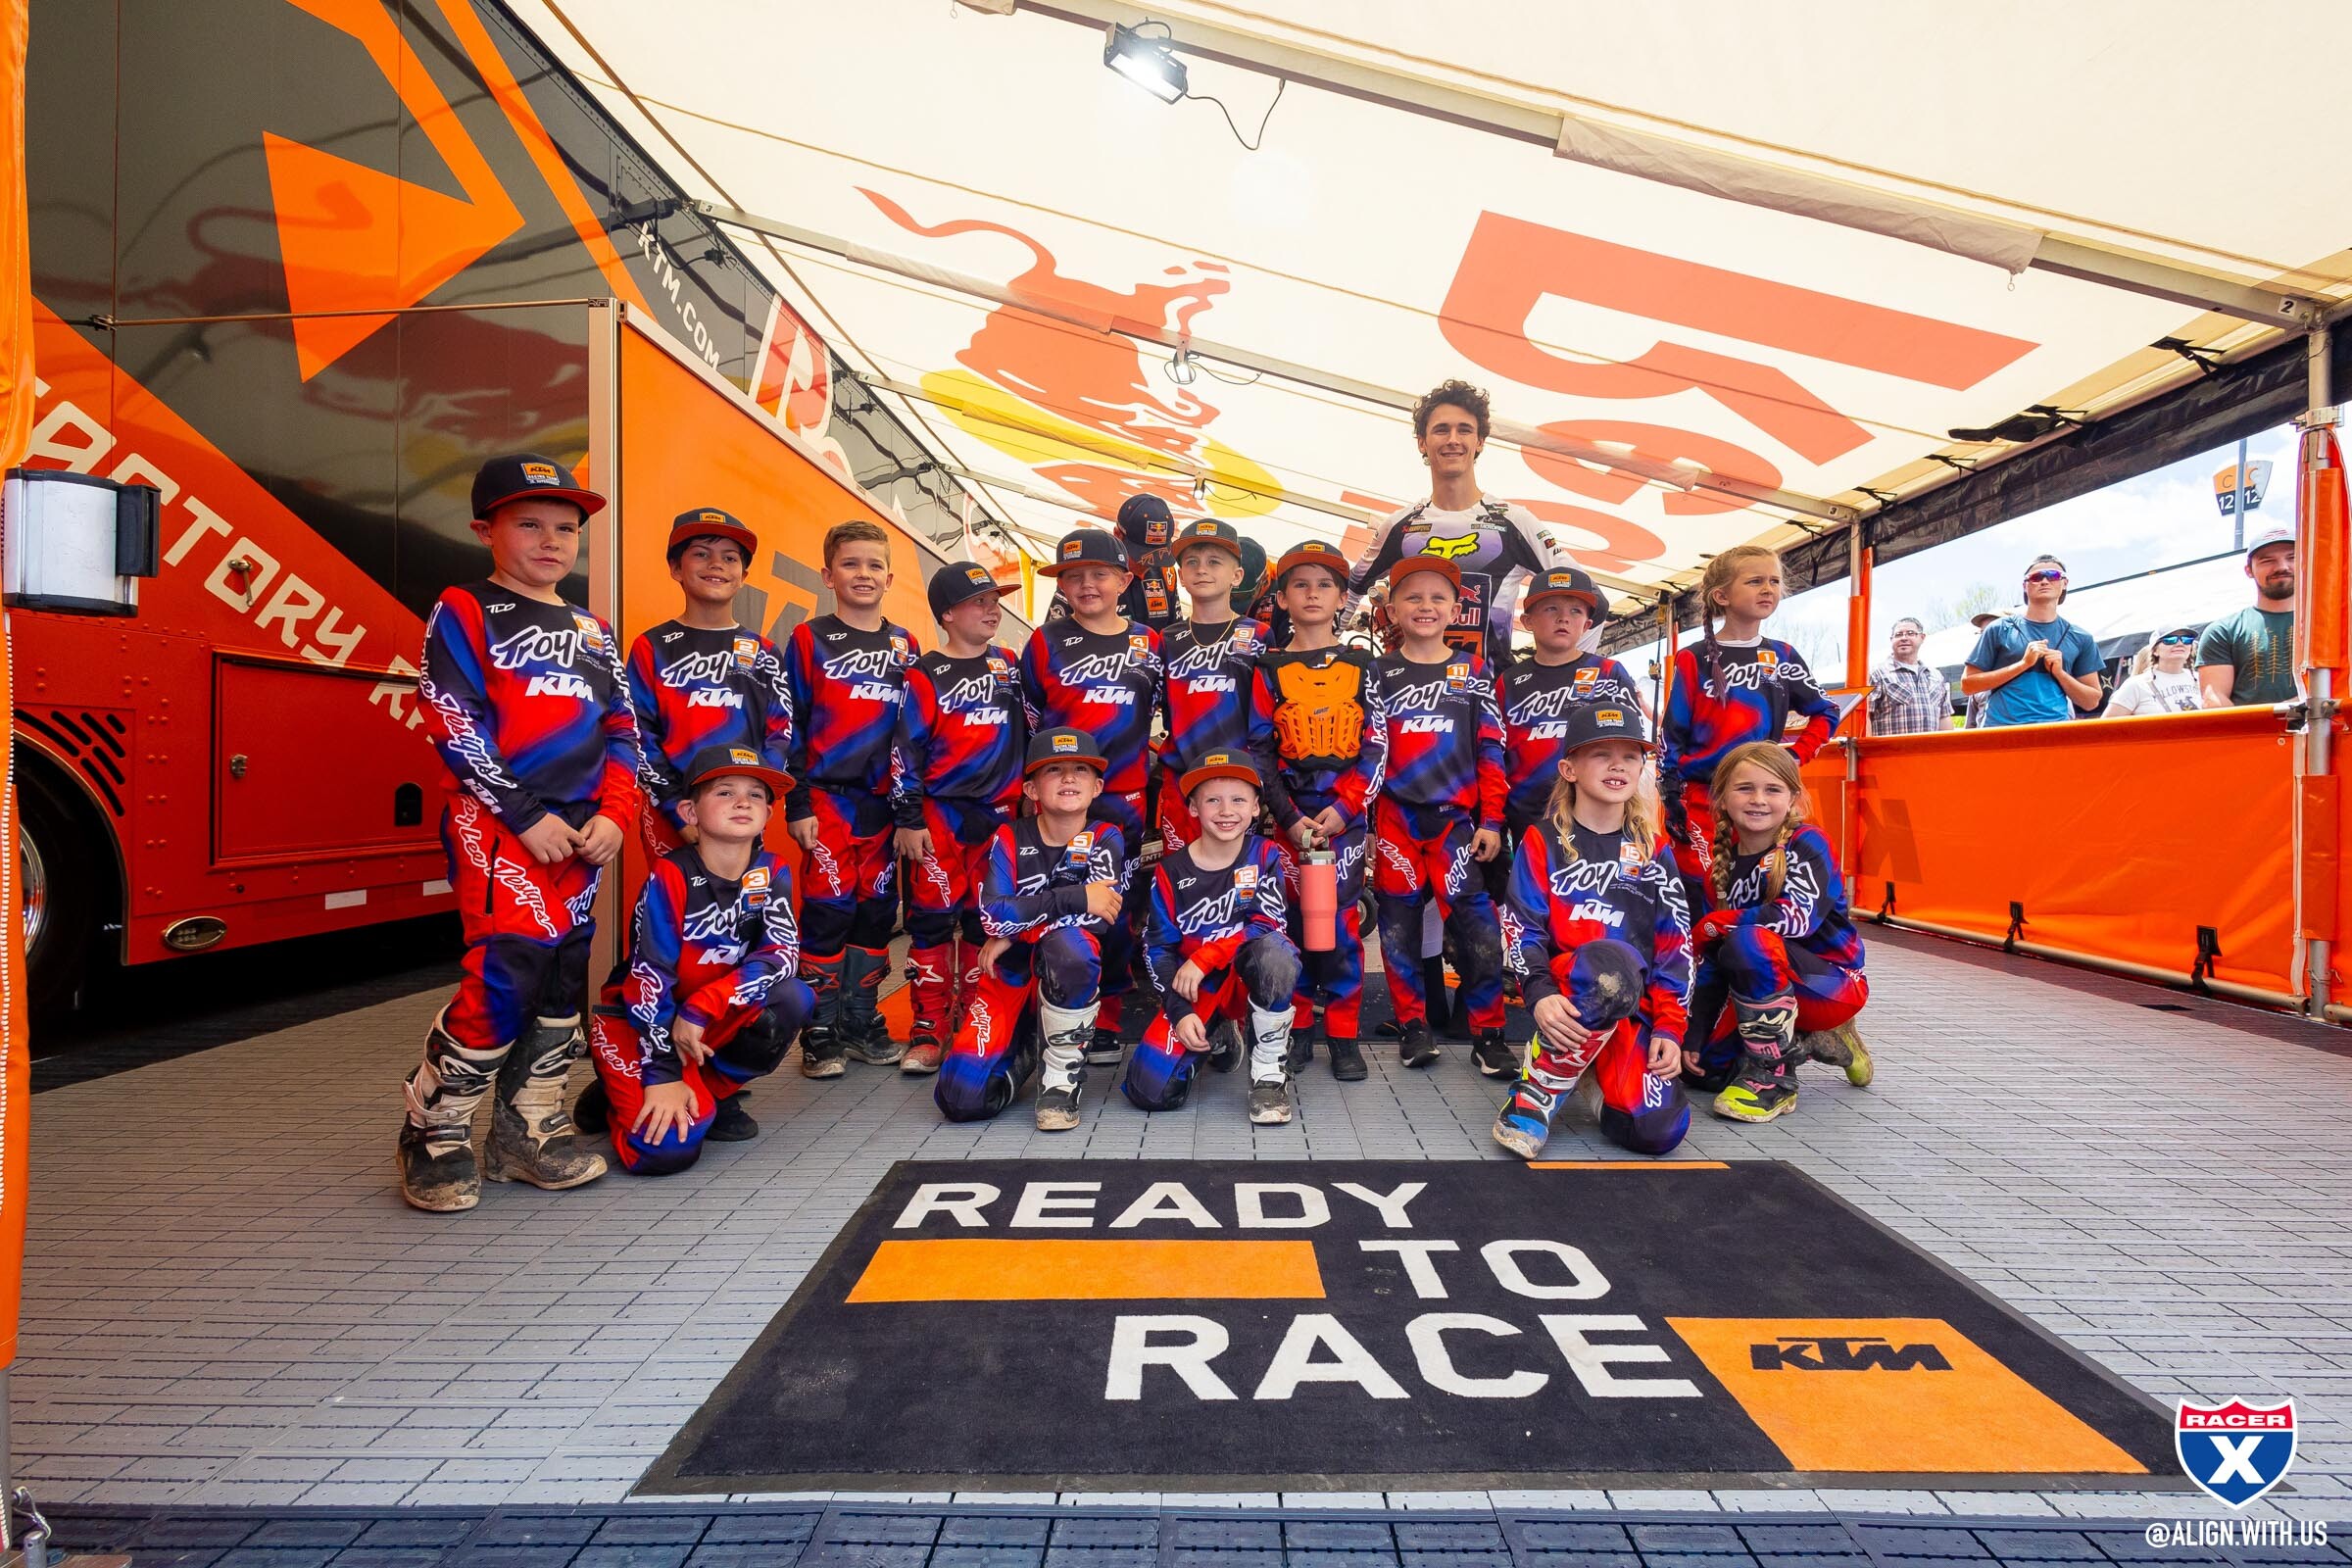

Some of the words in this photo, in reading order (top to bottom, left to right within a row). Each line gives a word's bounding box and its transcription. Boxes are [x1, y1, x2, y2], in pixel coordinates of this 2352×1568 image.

[638, 221, 720, 371] KTM.COM
[2280, 300, 2294, 314] 2
[2219, 494, 2234, 511] 12
[2244, 489, 2261, 505] 12
[577, 617, 595, 631] 10
[1451, 607, 1481, 627] ull
[490, 624, 577, 669] Troy
[739, 641, 754, 652] 2
[1133, 637, 1145, 648] 4
[660, 650, 731, 688] Troy
[823, 648, 891, 680] Troy
[990, 661, 1005, 671] 14
[1058, 653, 1124, 687] Troy
[1168, 639, 1227, 679] Troy
[1451, 665, 1466, 676] 11
[524, 670, 594, 703] KTM
[1187, 674, 1237, 695] KTM
[1582, 669, 1594, 680] 7
[687, 687, 744, 710] KTM
[849, 680, 902, 704] KTM
[938, 673, 995, 714] Troy
[1082, 685, 1136, 706] KTM
[1383, 680, 1446, 718] Troy
[1507, 686, 1569, 725] Troy
[963, 707, 1009, 727] KTM
[1400, 714, 1454, 734] KTM
[434, 692, 517, 789] Designs
[1072, 834, 1088, 846] 5
[1623, 845, 1639, 859] 15
[748, 872, 766, 886] 3
[1238, 870, 1254, 882] 12
[1377, 838, 1417, 891] Designs
[1549, 858, 1619, 897] Troy
[484, 856, 558, 938] Designs
[1176, 887, 1236, 935] Troy
[1569, 899, 1626, 928] KTM
[969, 997, 991, 1057] Designs
[893, 1181, 1428, 1229] READY
[1361, 1239, 1612, 1299] TO
[1104, 1312, 1703, 1401] RACE
[1750, 1337, 1955, 1372] KTM
